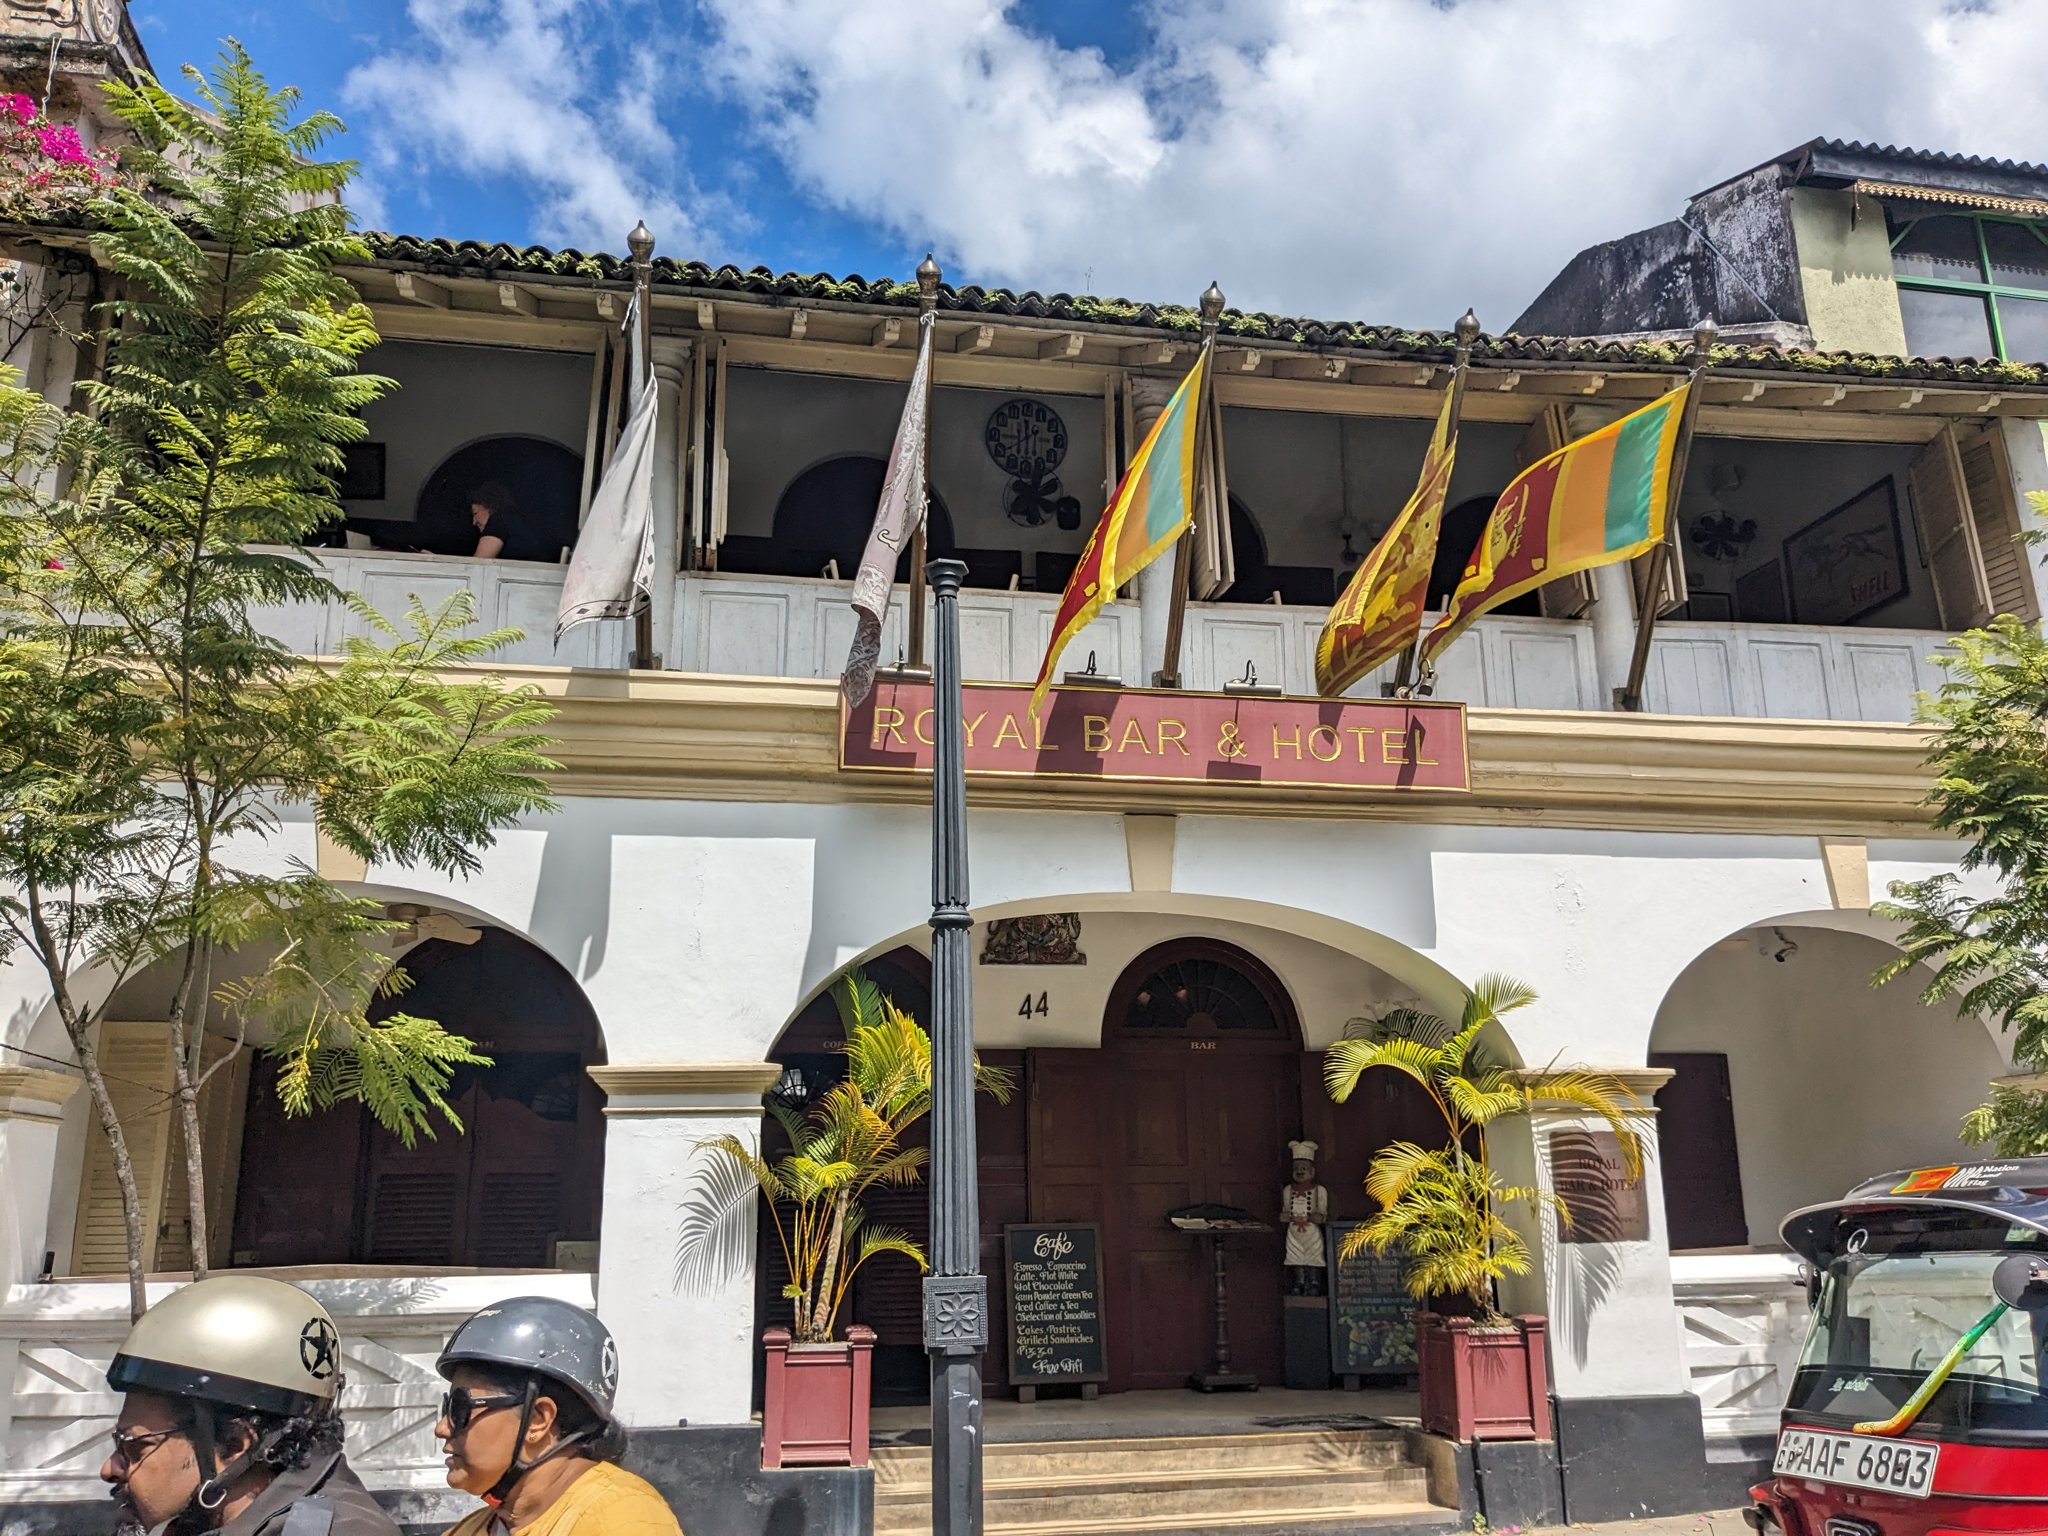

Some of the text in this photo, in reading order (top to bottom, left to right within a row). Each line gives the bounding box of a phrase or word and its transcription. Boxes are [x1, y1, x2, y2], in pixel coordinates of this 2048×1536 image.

[872, 705, 1439, 766] ROYAL BAR & HOTEL
[1018, 991, 1049, 1020] 44
[1190, 1041, 1217, 1050] BAR
[1579, 1158, 1621, 1170] ROYAL
[1983, 1164, 2020, 1172] Nation
[1047, 1260, 1087, 1271] Cappuccino
[1039, 1271, 1056, 1281] Flat
[1058, 1270, 1079, 1280] White
[1014, 1280, 1074, 1292] Hot Chocolate
[1034, 1291, 1060, 1301] Powder
[1061, 1291, 1081, 1300] Green
[1081, 1290, 1093, 1299] Tea
[1015, 1302, 1034, 1312] Iced
[1035, 1301, 1058, 1311] Coffee
[1066, 1301, 1079, 1310] Tea
[1055, 1310, 1063, 1321] of
[1064, 1309, 1096, 1320] Smoothies
[1046, 1323, 1081, 1334] Pastries
[1017, 1332, 1094, 1345] Grilled Sandwiches
[1016, 1345, 1054, 1359] Pizza
[1797, 1436, 1851, 1477] AAF
